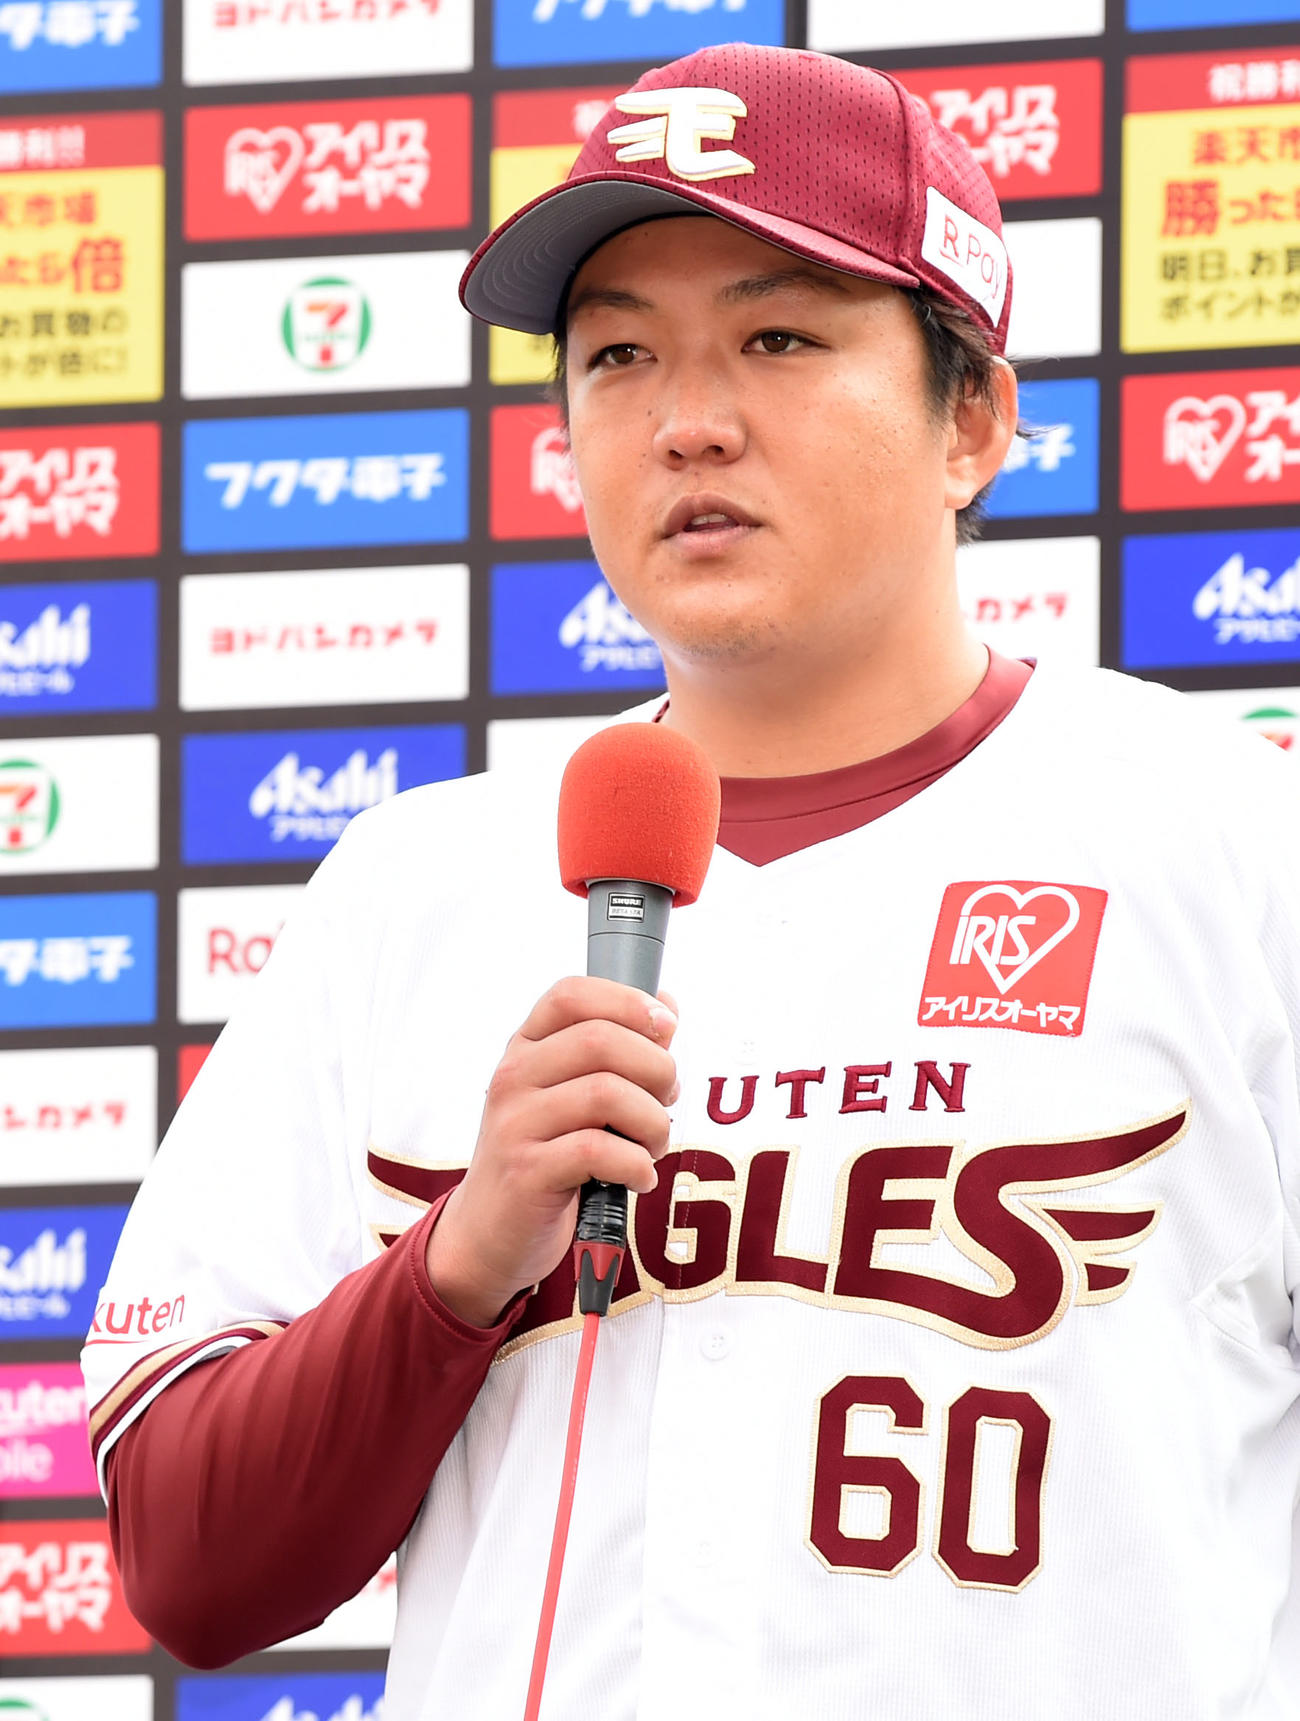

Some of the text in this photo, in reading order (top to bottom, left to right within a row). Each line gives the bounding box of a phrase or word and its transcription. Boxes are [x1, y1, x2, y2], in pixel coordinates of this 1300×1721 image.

[1162, 179, 1300, 238] 勝った
[249, 747, 399, 819] Asahi
[949, 915, 1037, 965] IRIS
[922, 996, 1081, 1031] アイリスオーヤマ
[707, 1060, 973, 1126] UTEN
[805, 1372, 1055, 1595] 60
